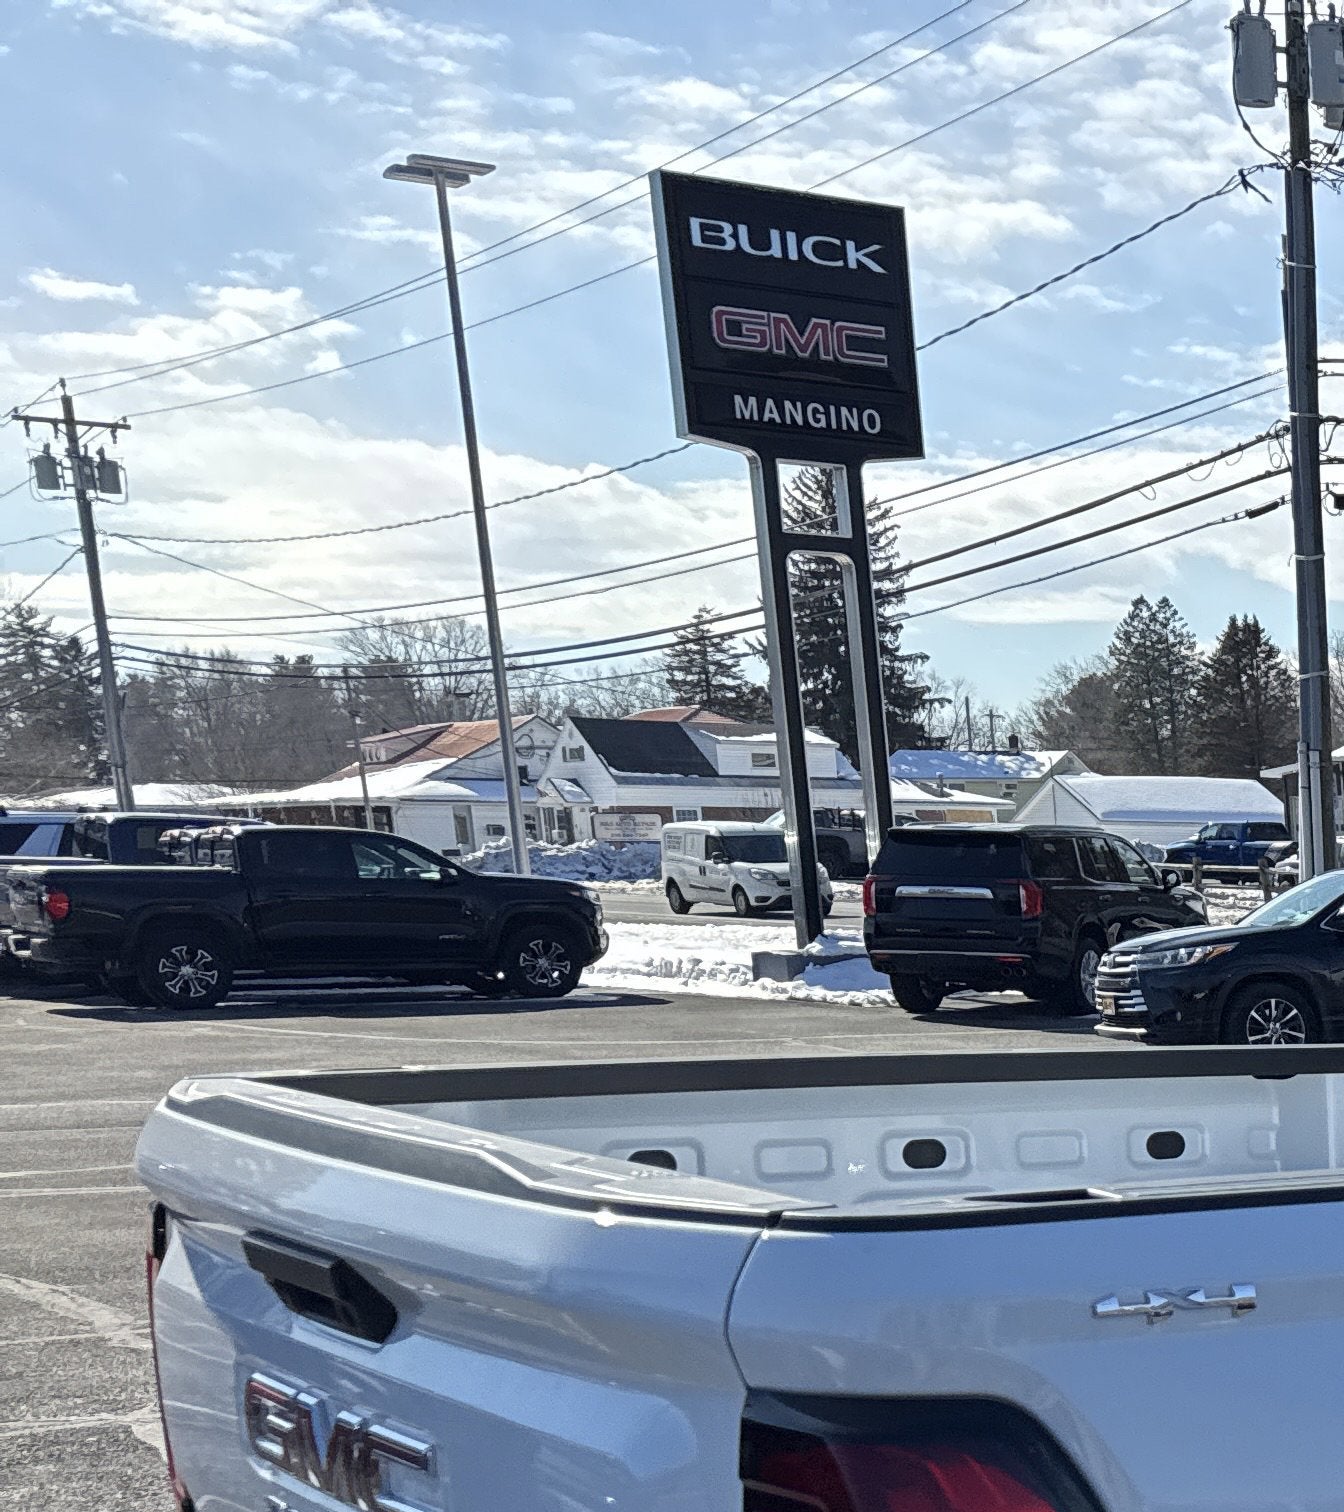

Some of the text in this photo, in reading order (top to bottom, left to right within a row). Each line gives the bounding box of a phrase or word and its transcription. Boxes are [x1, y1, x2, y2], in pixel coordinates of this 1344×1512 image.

[689, 216, 888, 274] BUICK
[712, 305, 889, 368] GMC
[733, 394, 882, 435] MANGINO
